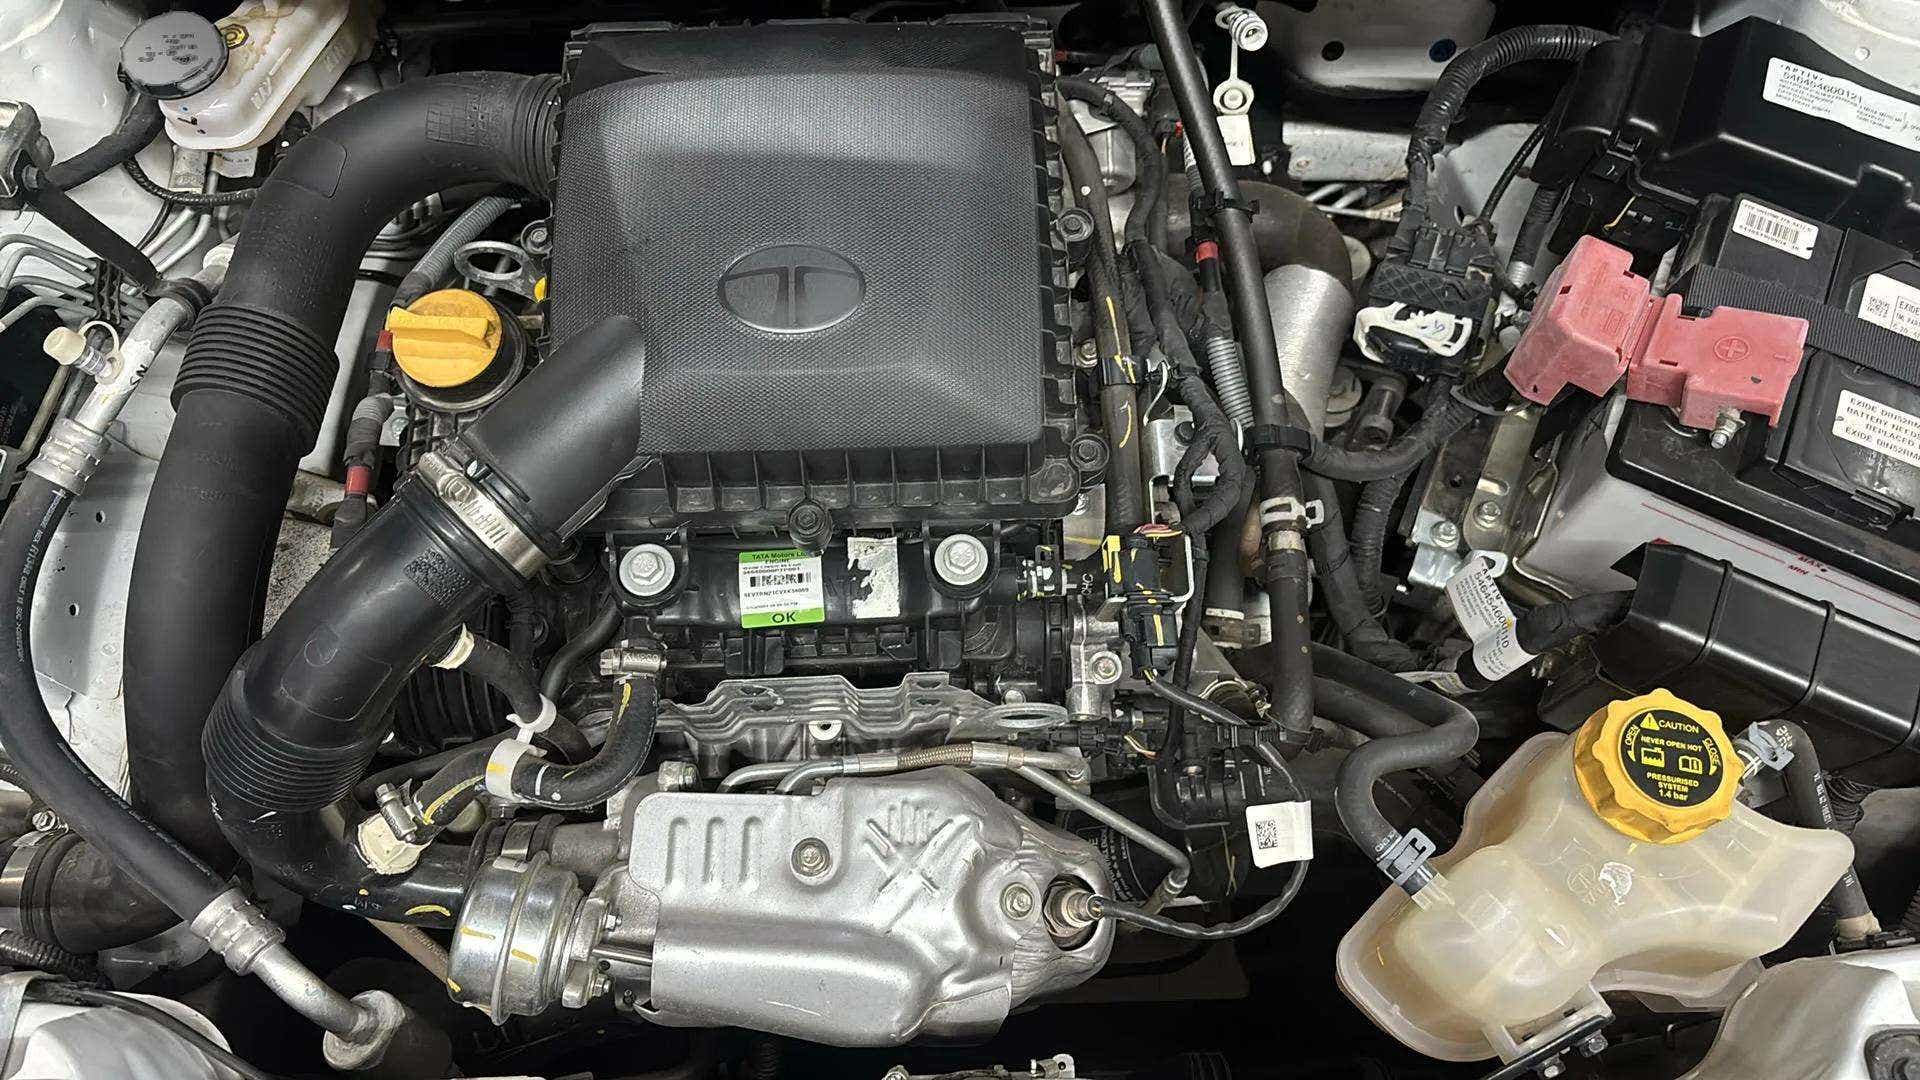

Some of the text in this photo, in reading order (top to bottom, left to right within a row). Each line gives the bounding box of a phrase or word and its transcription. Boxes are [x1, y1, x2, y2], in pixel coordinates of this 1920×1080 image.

[752, 553, 770, 561] TATA
[771, 552, 795, 560] Motors
[772, 611, 797, 624] OK
[1658, 719, 1700, 734] CAUTION
[1624, 723, 1640, 746] OPEN
[1640, 735, 1703, 752] NEVER OPEN HOT
[1703, 737, 1721, 767] CLOSE
[1646, 771, 1700, 788] PRESSURISED
[1658, 781, 1689, 793] SYSTEM
[1659, 789, 1689, 801] 1.4 bar
